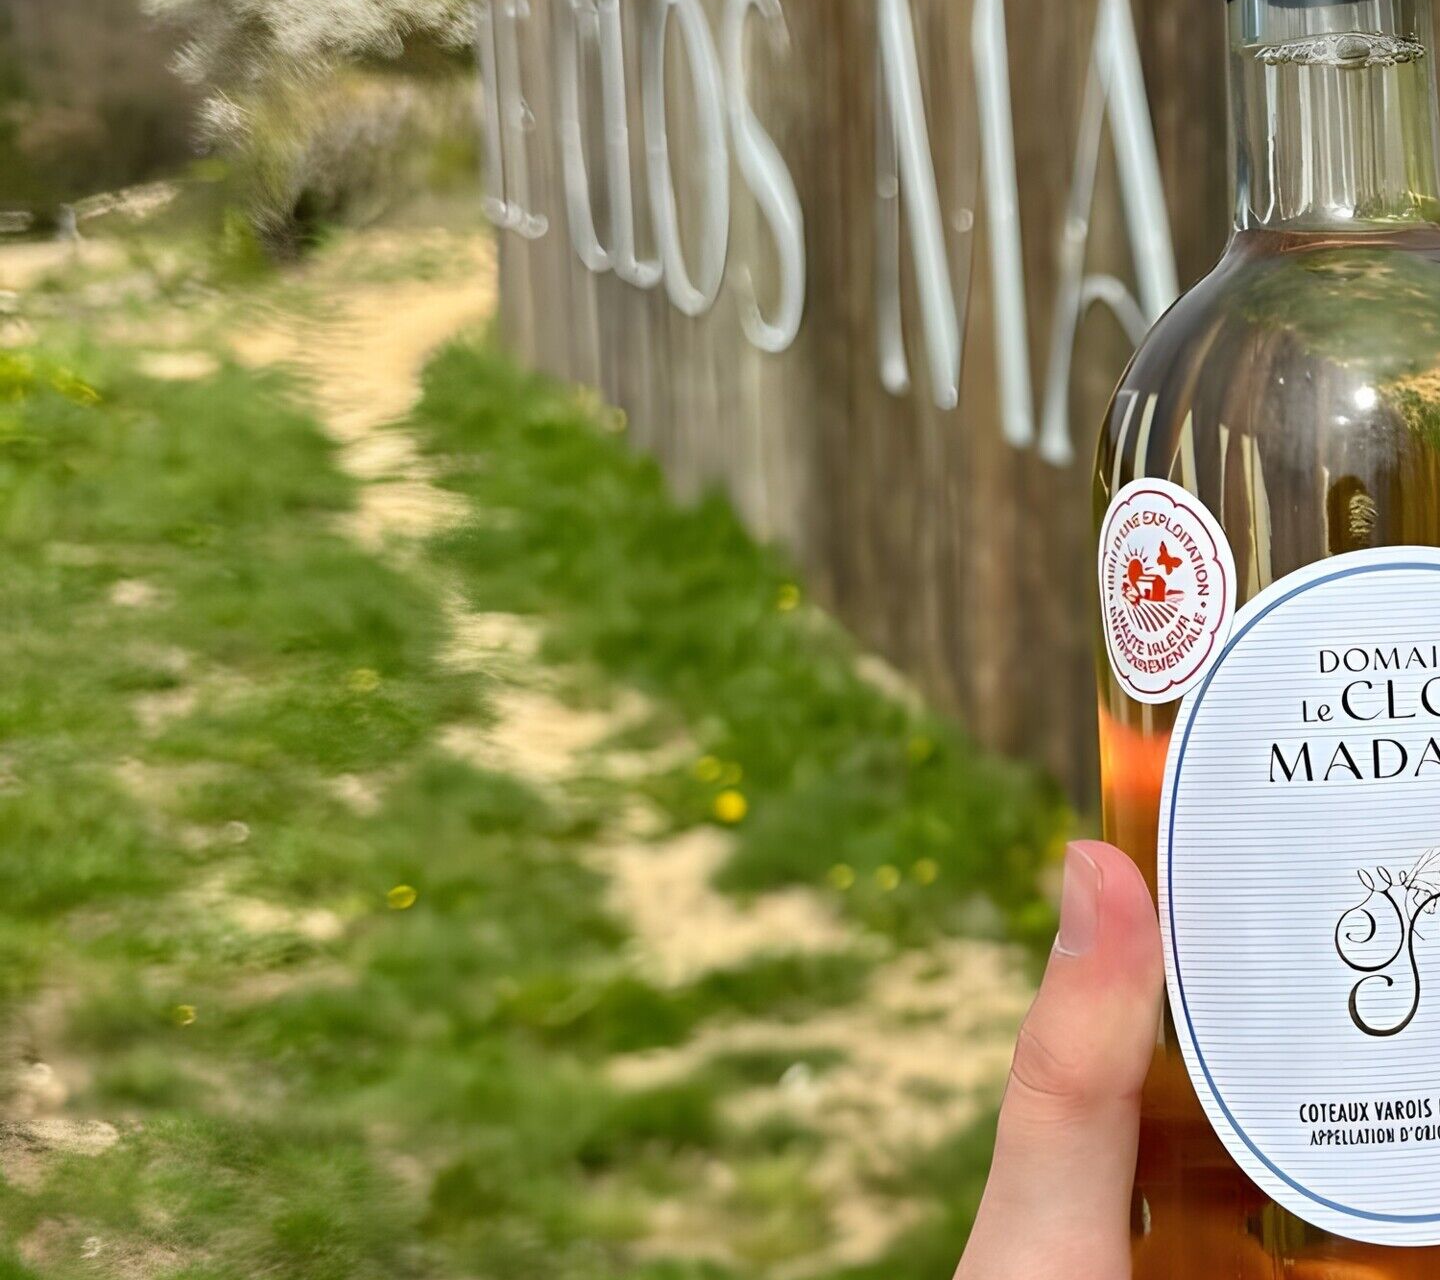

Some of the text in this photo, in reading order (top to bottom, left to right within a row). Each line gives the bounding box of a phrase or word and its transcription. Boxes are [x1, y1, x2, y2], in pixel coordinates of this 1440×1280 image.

[1299, 1102, 1369, 1123] COTEAUX
[1374, 1098, 1433, 1120] VAROIS
[1310, 1127, 1395, 1146] APPELLATION
